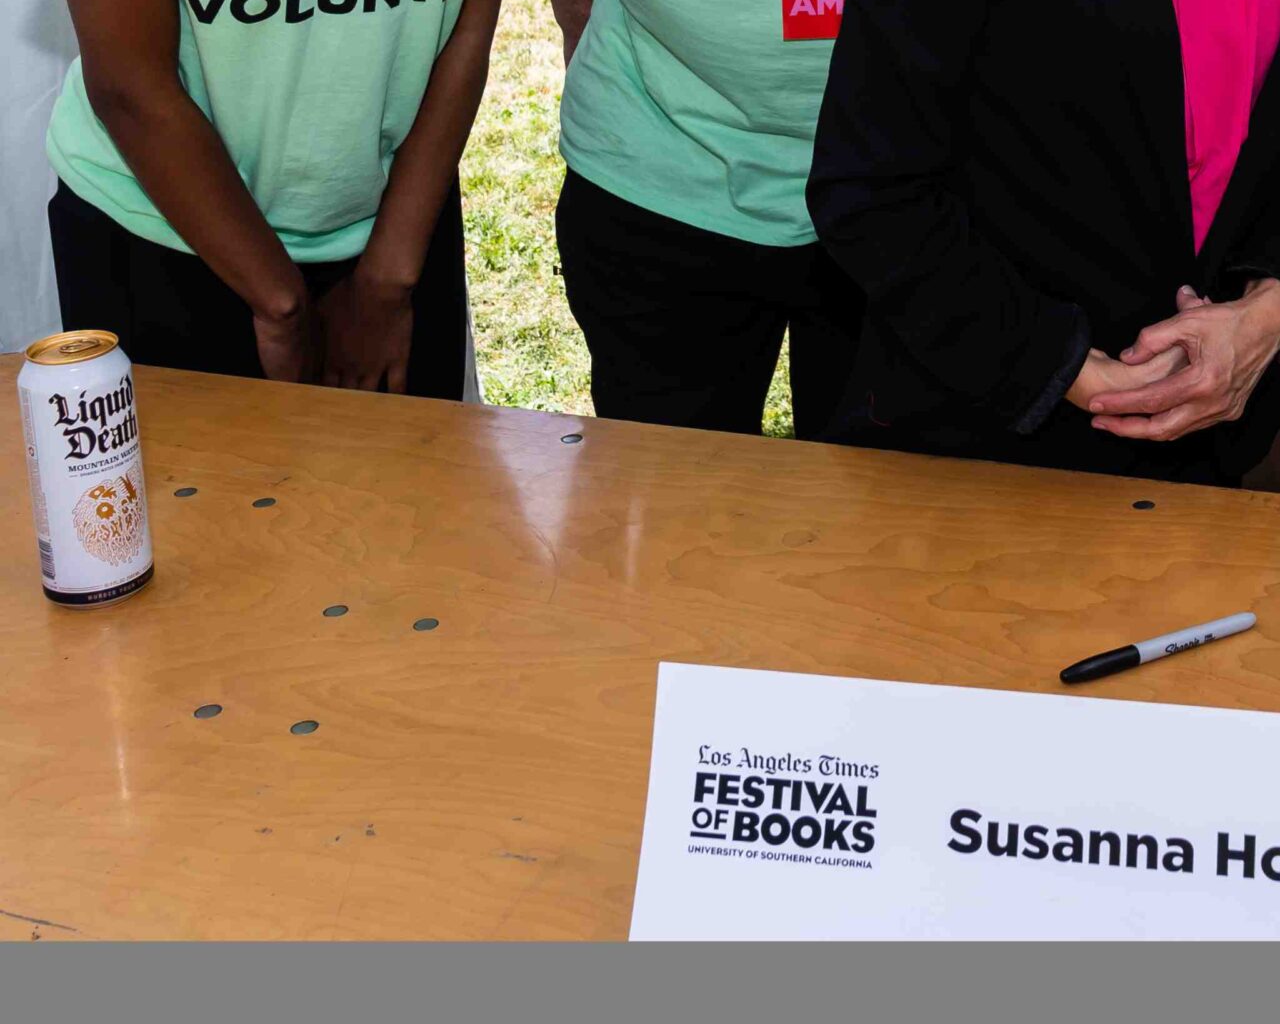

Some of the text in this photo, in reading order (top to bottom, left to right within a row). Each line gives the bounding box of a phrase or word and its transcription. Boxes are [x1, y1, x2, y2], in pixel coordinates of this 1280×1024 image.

[62, 407, 138, 460] Death
[68, 455, 119, 473] MOUNTAIN
[698, 744, 880, 779] Los Angeles Times
[693, 771, 878, 818] FESTIVAL
[691, 807, 876, 854] OF BOOKS
[946, 808, 1195, 874] Susanna
[687, 844, 873, 870] UNIVERSITY OF SOUTHERN CALIFORNIA
